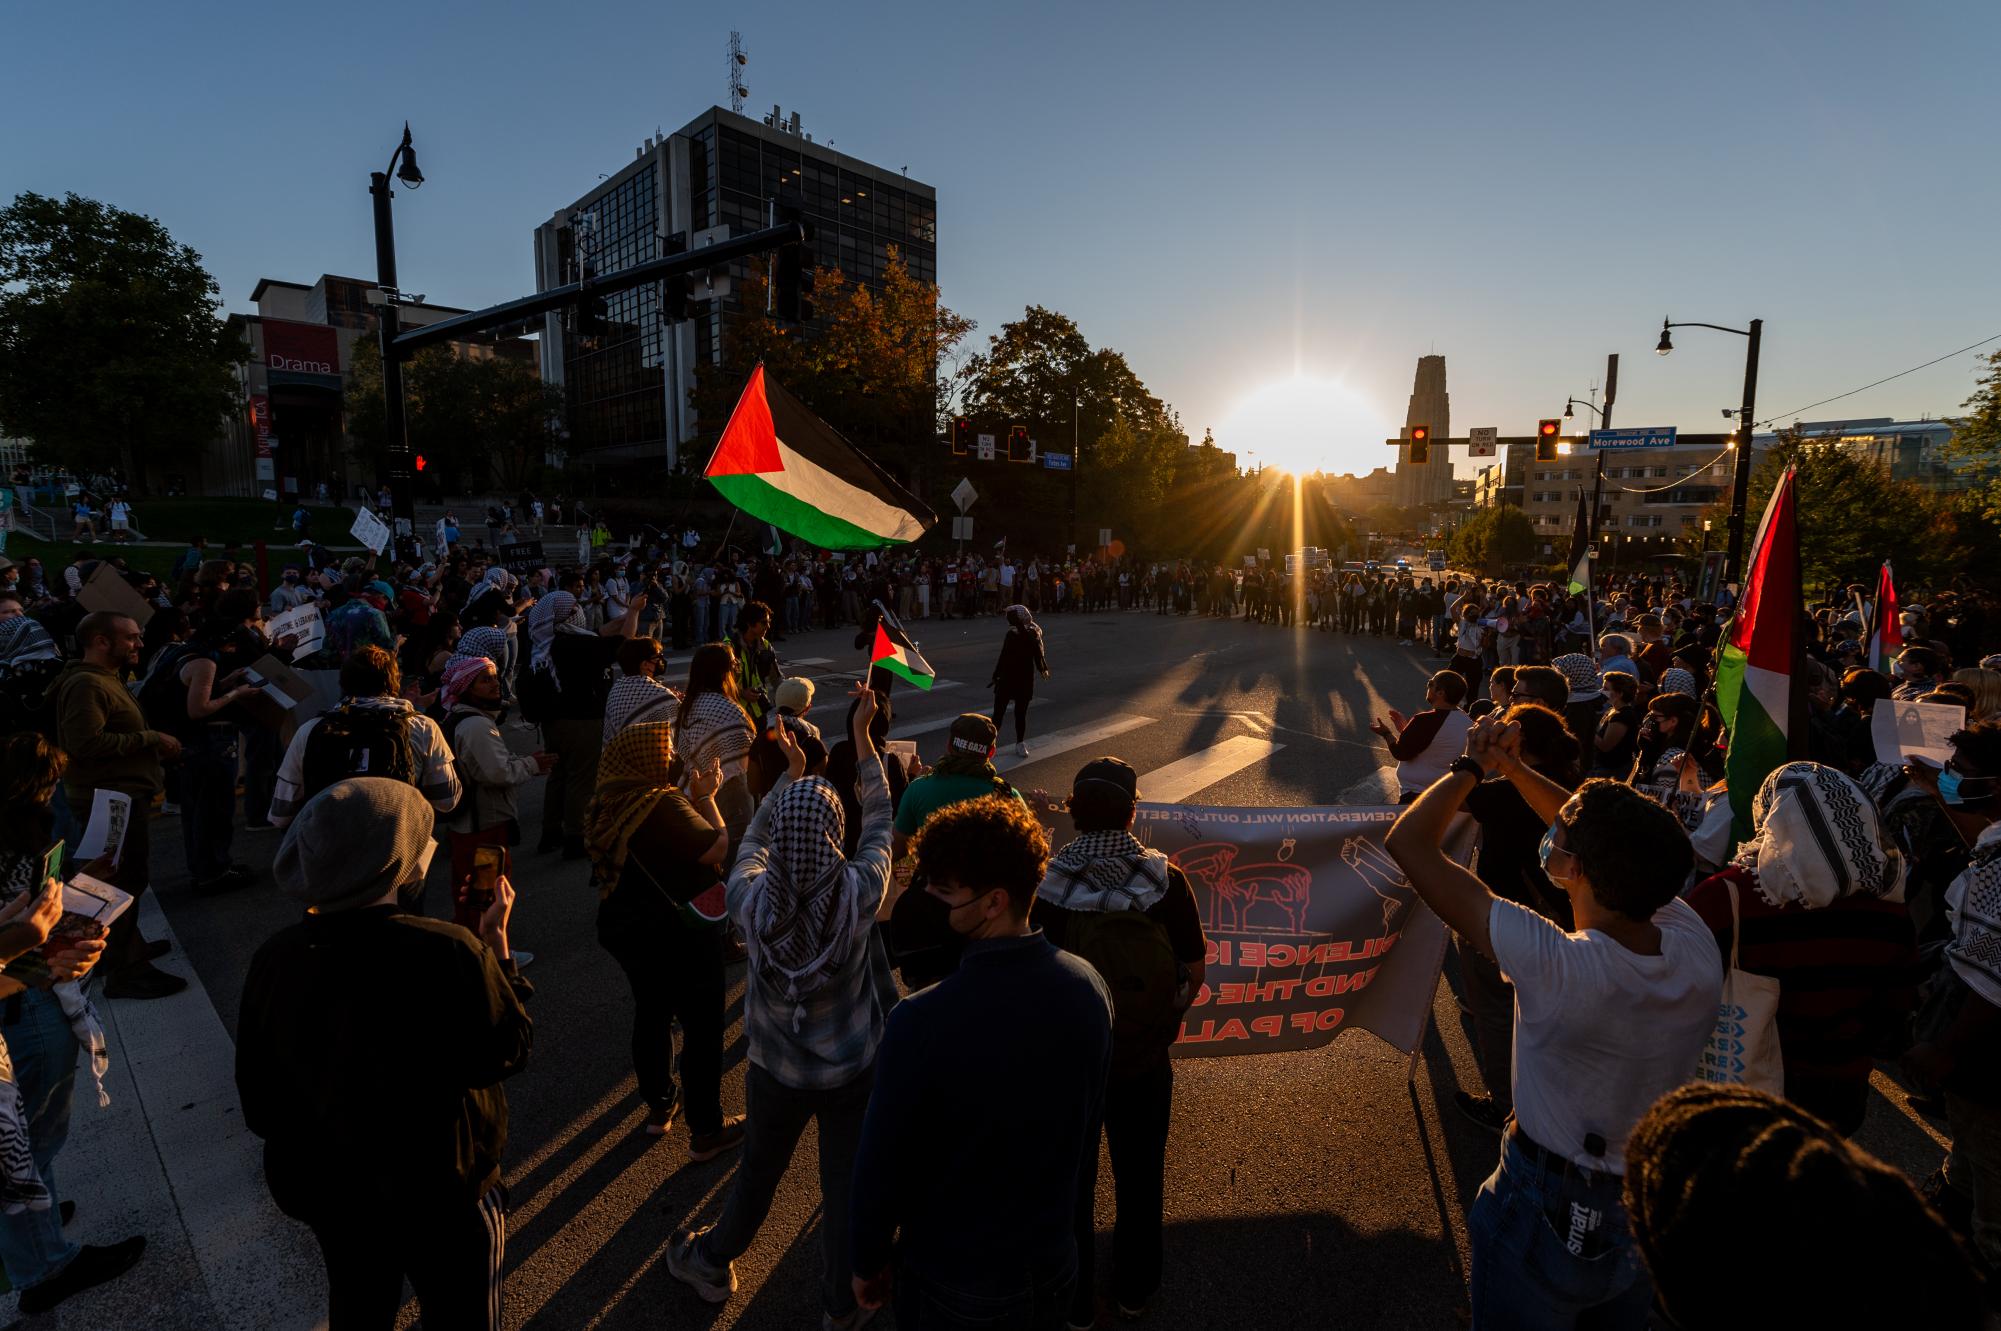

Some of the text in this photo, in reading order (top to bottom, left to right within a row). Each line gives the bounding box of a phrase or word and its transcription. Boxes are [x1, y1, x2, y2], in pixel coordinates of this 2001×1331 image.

[271, 354, 331, 374] Drama
[1593, 436, 1670, 447] Morewood Ave
[953, 737, 988, 754] FREE GAZA
[1567, 1200, 1590, 1255] smart
